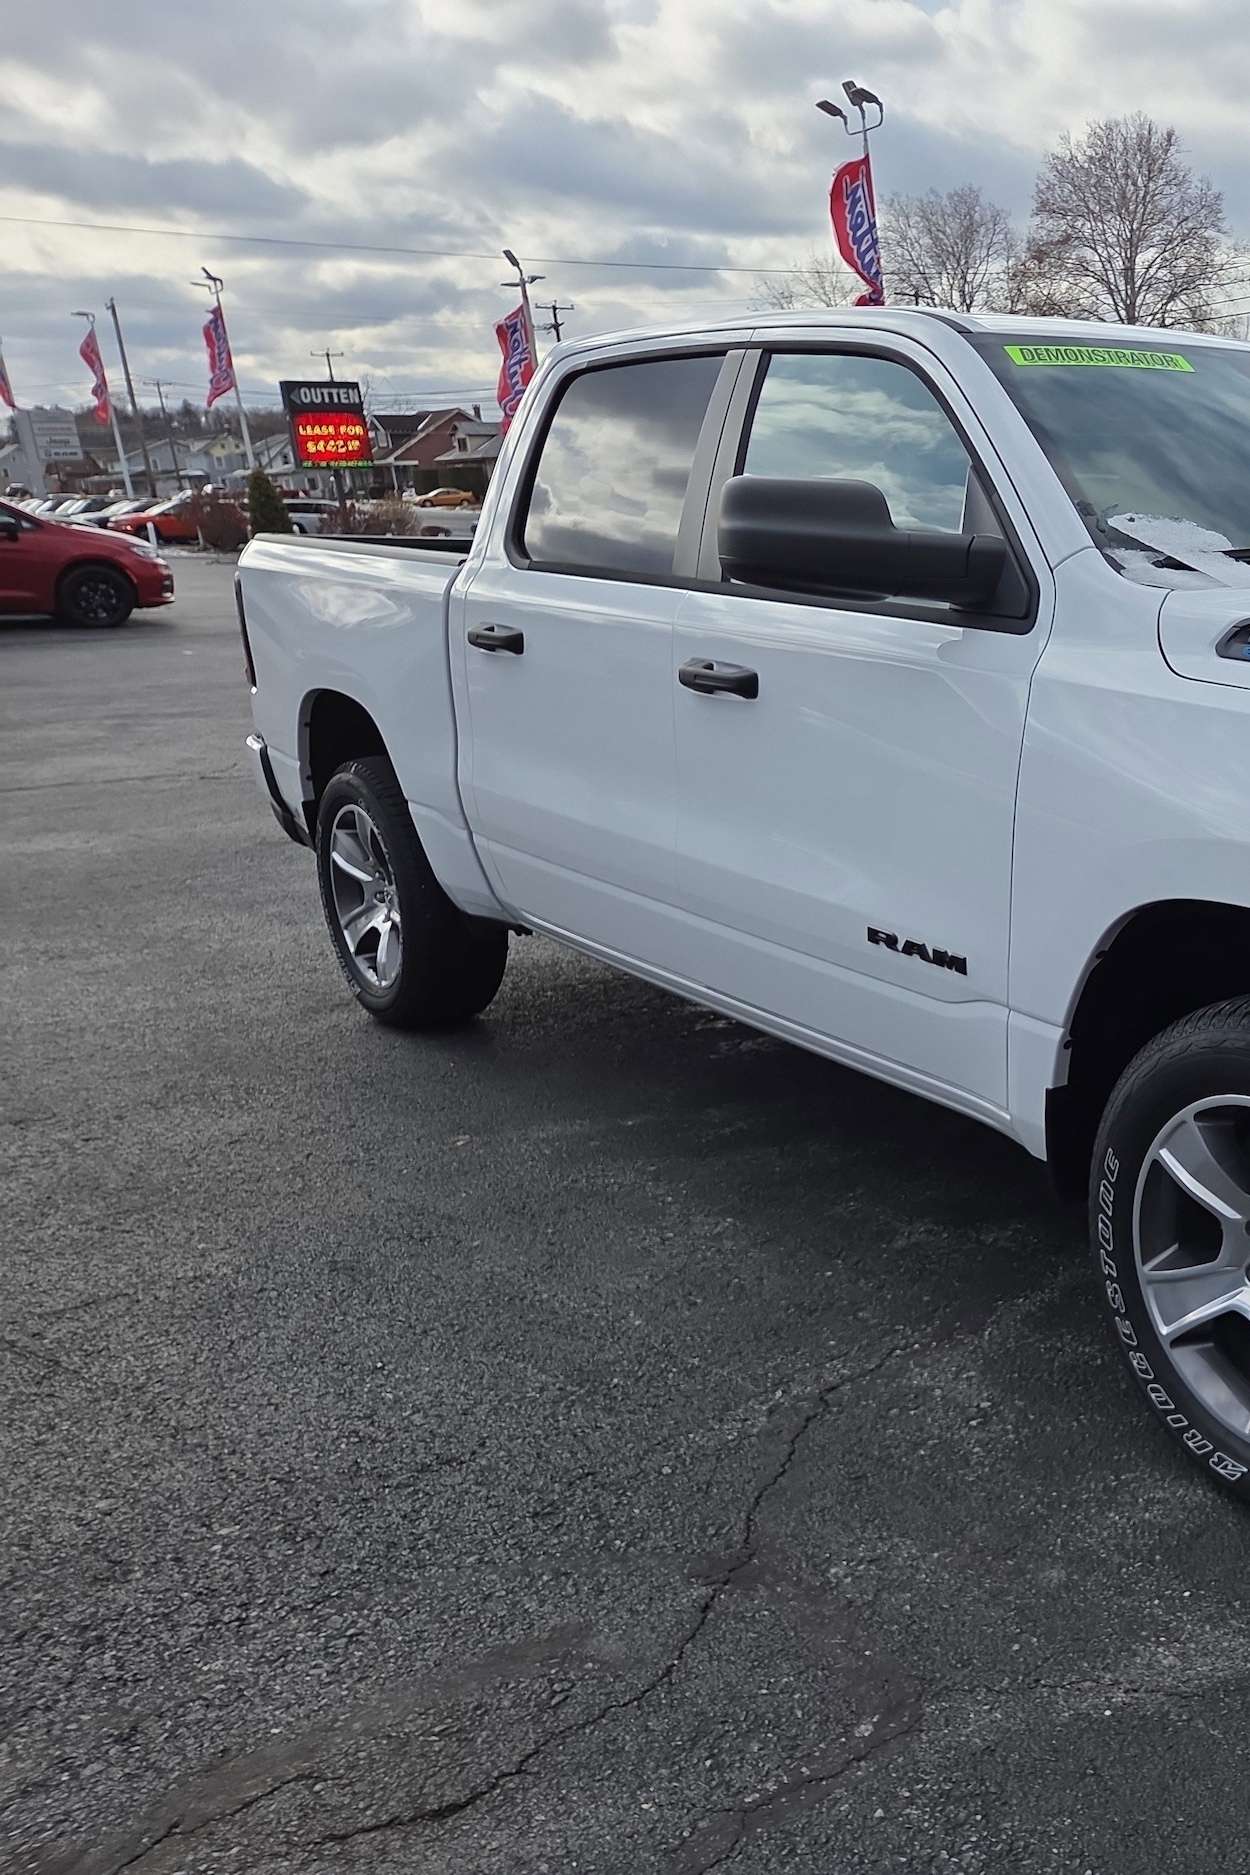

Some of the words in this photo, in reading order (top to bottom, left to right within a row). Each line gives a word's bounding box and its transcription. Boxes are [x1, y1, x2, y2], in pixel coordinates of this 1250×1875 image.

[1019, 347, 1184, 369] DEMONSTRATOR
[300, 386, 360, 404] OUTTEN
[298, 424, 336, 436] LEASE
[339, 424, 364, 436] FOR
[866, 926, 968, 976] RAM
[1098, 1147, 1249, 1482] BRIDGESTONE
